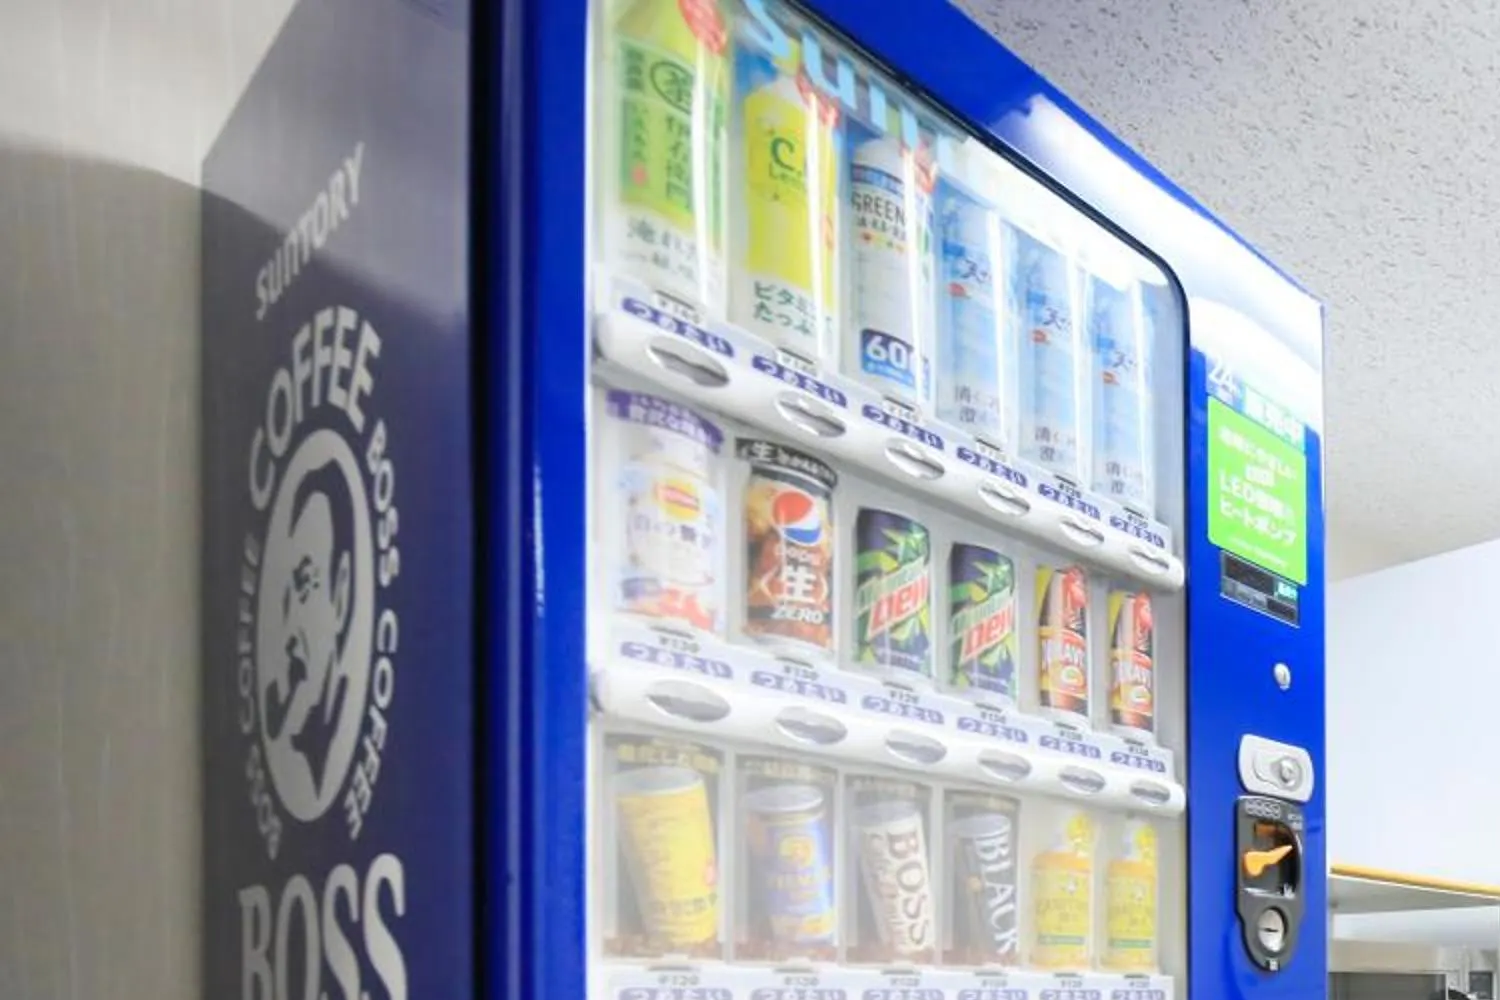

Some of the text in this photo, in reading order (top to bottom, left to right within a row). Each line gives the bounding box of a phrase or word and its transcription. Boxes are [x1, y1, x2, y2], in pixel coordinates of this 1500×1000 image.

[256, 141, 366, 320] SUNTORY
[249, 304, 381, 511] COFFEE
[343, 418, 399, 841] BOSS COFFEE
[975, 836, 1019, 955] BLACK
